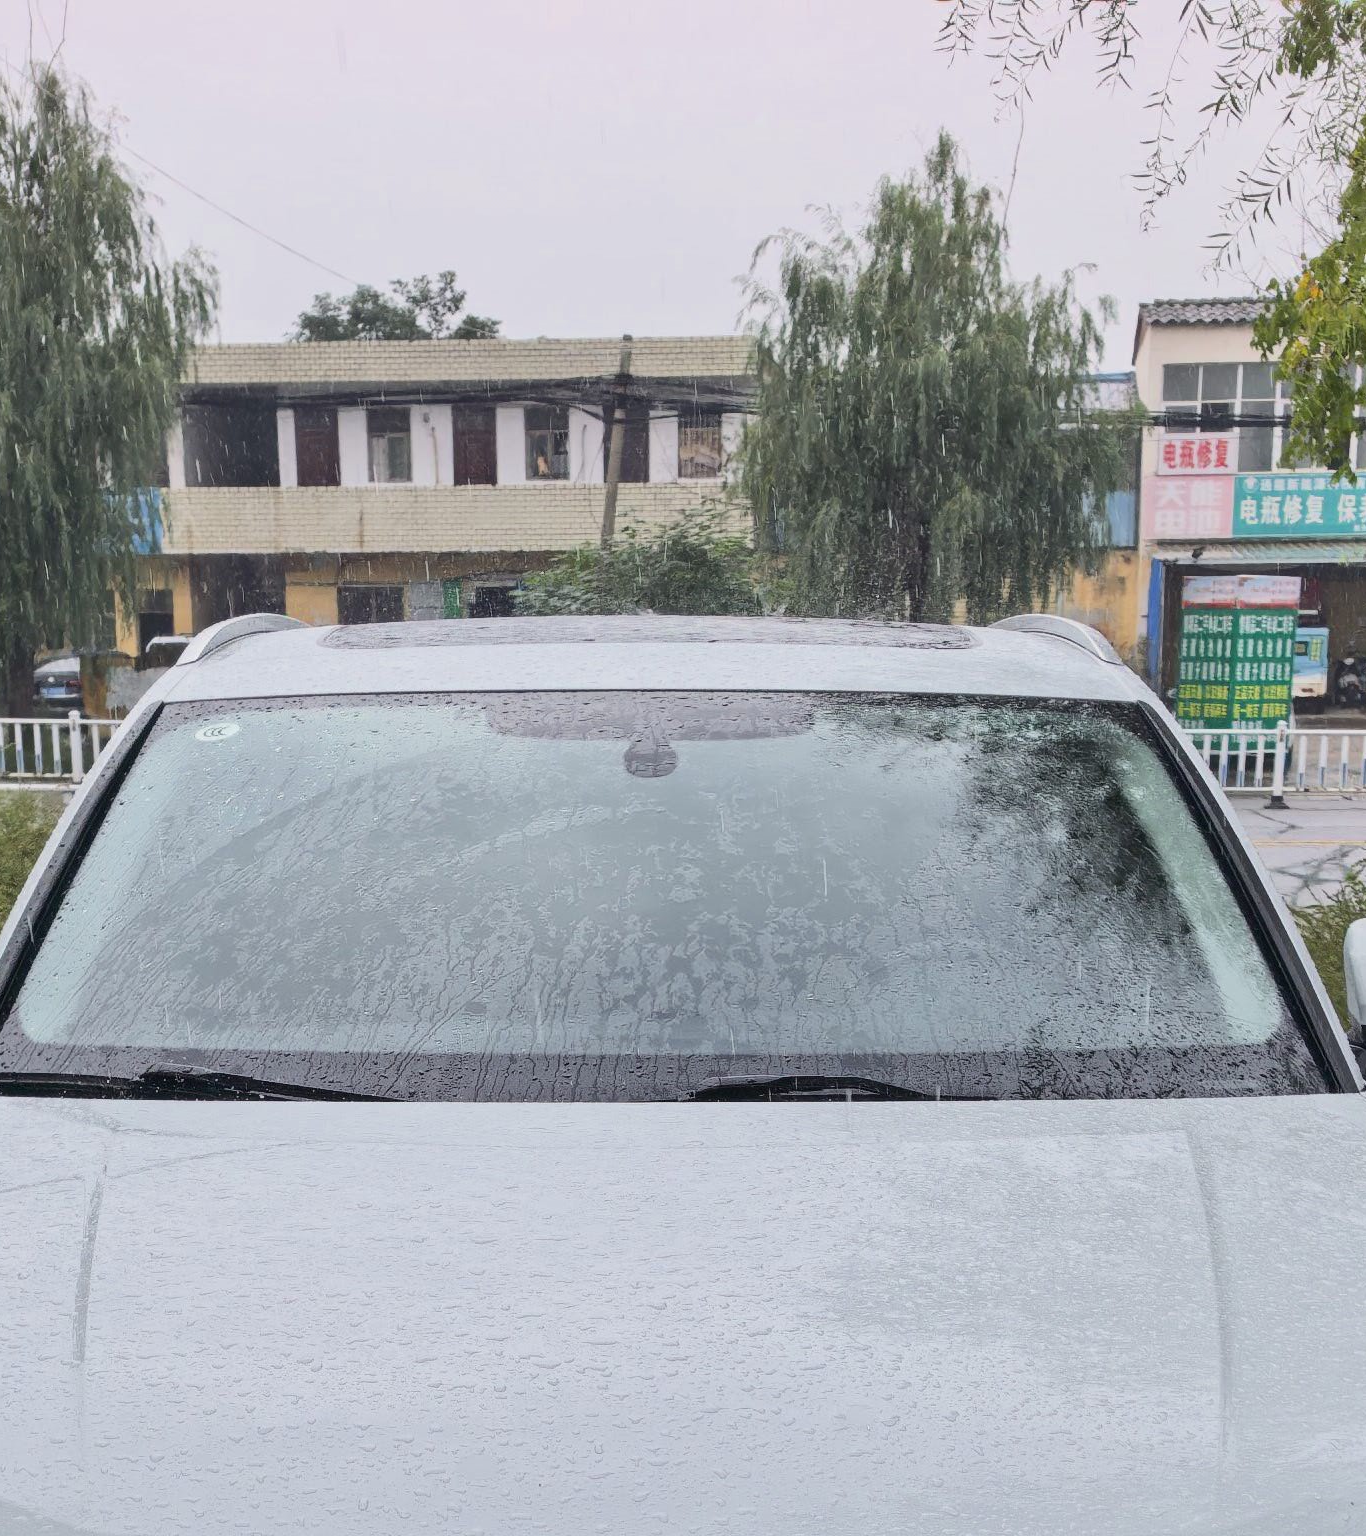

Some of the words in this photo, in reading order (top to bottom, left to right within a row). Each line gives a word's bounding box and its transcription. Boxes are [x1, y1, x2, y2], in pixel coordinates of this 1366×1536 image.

[1163, 439, 1229, 469] 电瓶修复
[1154, 480, 1224, 506] 天能
[1154, 508, 1224, 537] 电池
[1240, 495, 1324, 525] 电瓶修复
